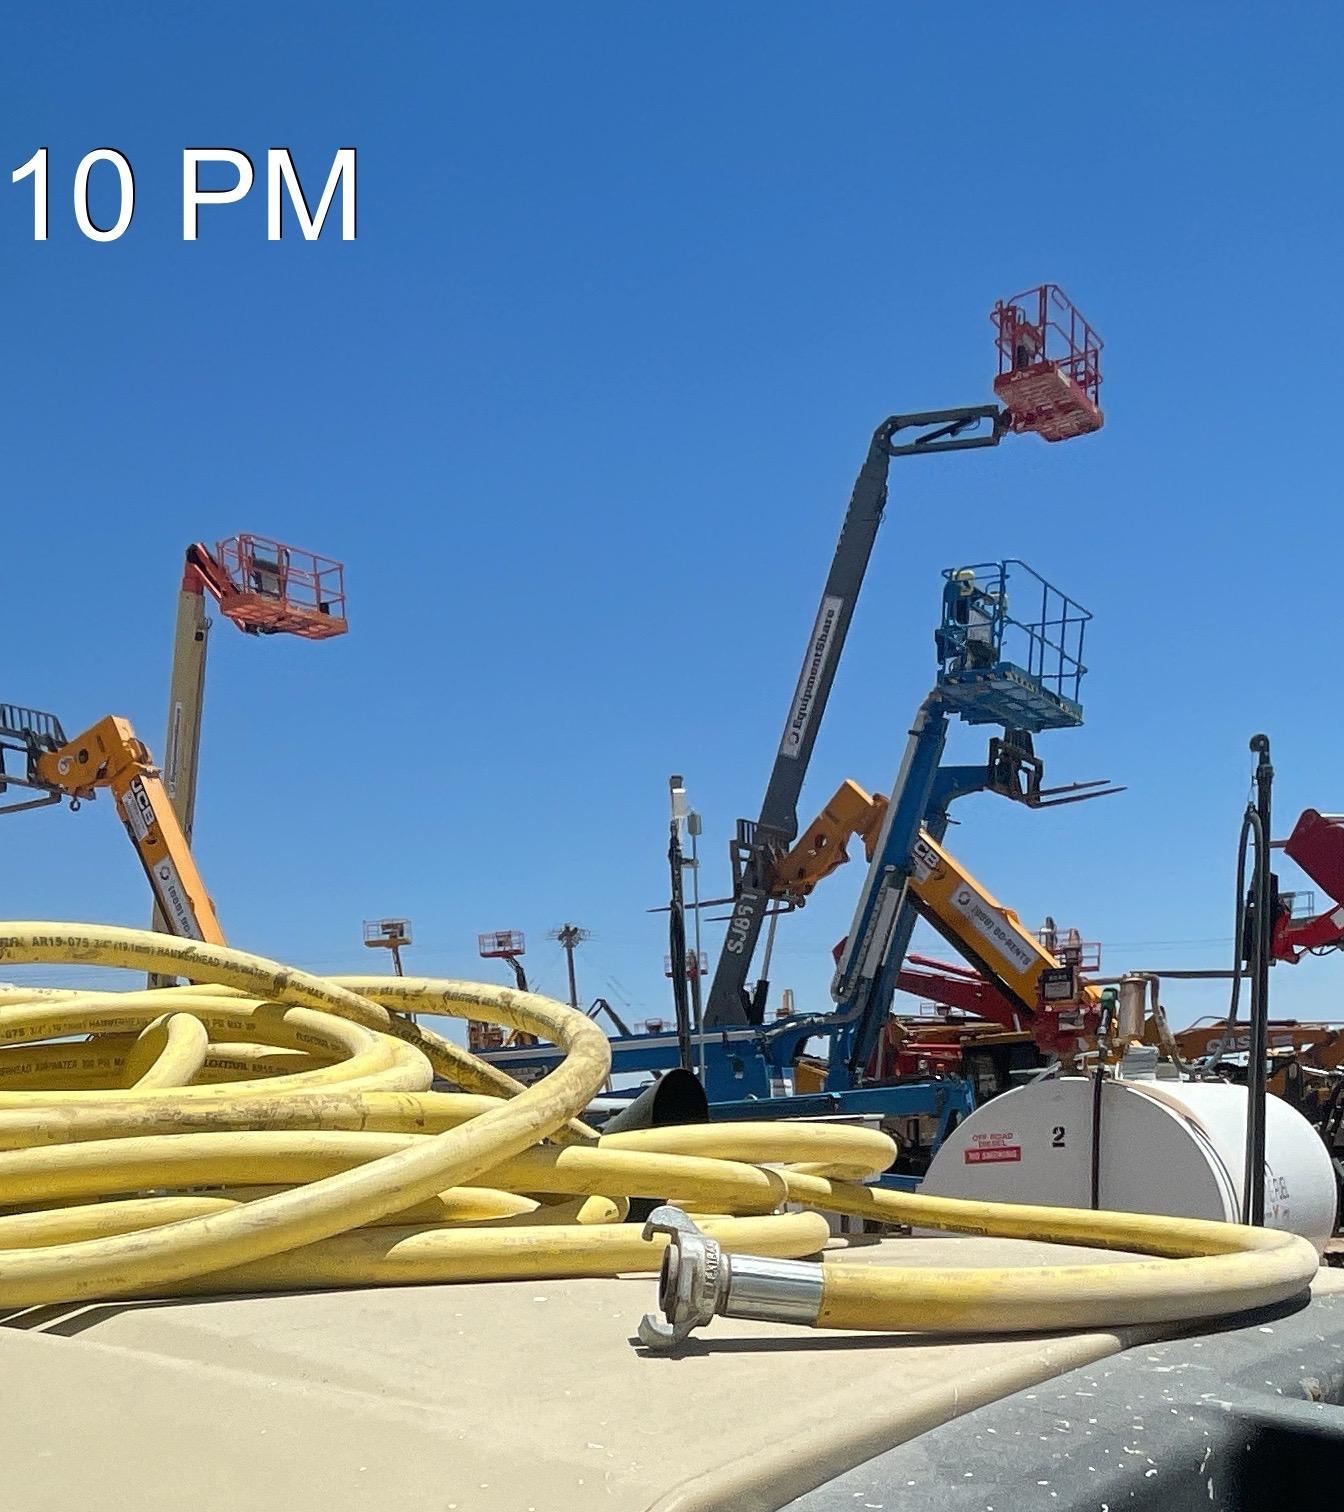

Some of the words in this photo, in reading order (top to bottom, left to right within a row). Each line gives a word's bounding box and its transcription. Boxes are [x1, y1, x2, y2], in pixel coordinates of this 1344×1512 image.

[130, 779, 156, 826] JCB
[913, 839, 940, 868] CB
[1051, 1125, 1066, 1148] 2
